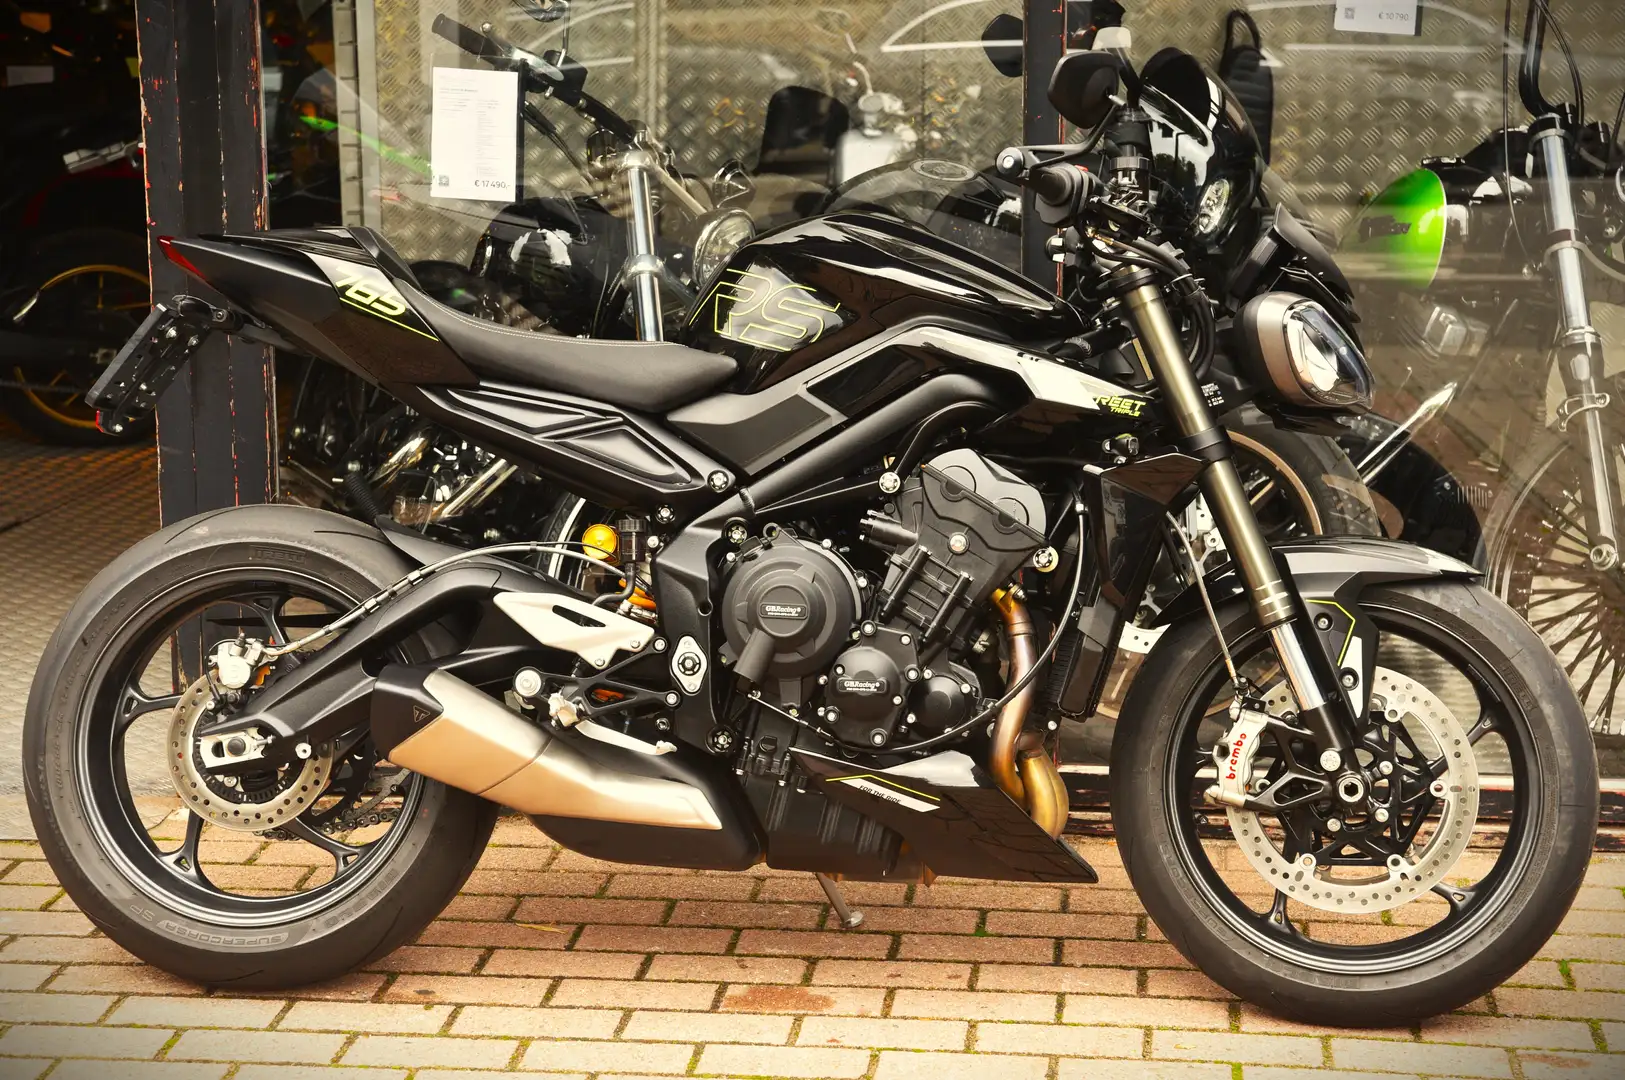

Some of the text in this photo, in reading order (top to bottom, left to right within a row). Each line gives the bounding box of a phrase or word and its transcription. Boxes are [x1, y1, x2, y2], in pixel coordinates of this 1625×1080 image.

[474, 179, 480, 188] €
[336, 265, 407, 316] 765
[689, 268, 841, 351] RS
[1111, 407, 1140, 417] TRIPLE
[1226, 733, 1247, 780] brembo
[859, 785, 902, 805] FOR THE RIDE
[129, 904, 283, 945] SUPERCORSA SP
